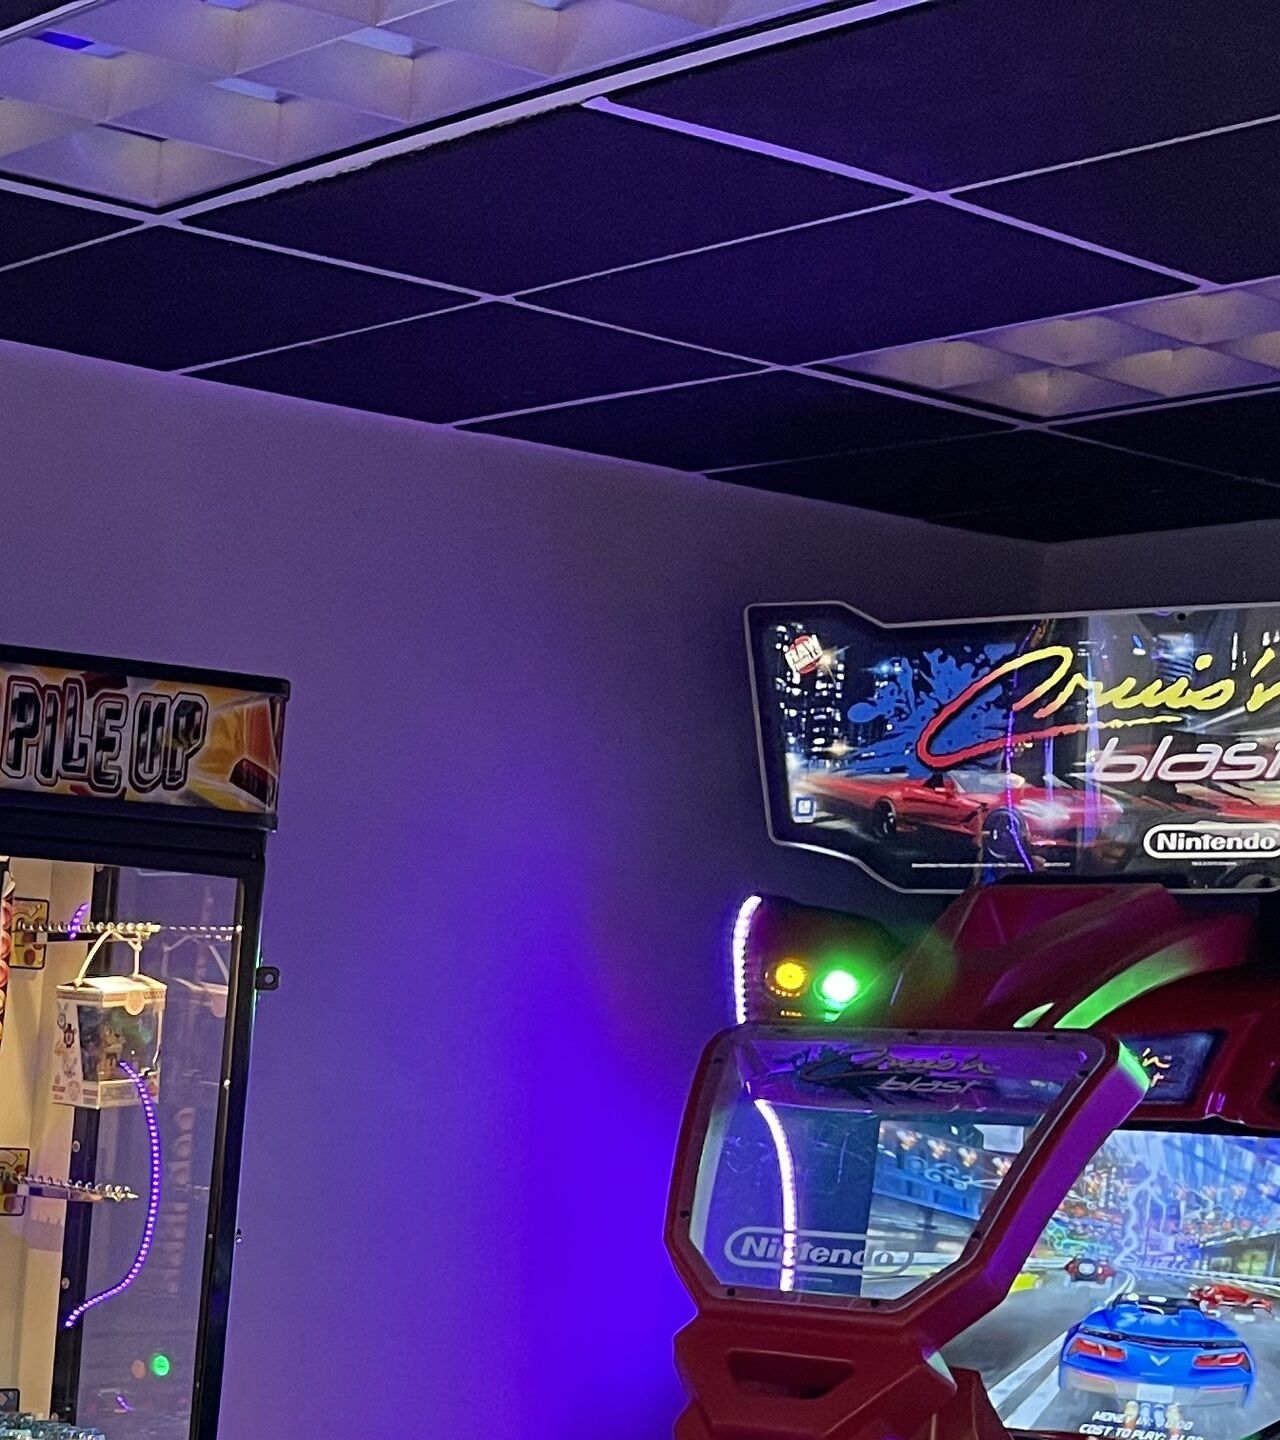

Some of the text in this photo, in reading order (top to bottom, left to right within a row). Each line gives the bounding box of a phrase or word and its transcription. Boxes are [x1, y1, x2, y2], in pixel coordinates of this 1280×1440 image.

[0, 674, 210, 794] PILE UP
[1093, 734, 1280, 783] blas
[1156, 831, 1277, 852] Nintendo
[876, 1075, 982, 1093] blast
[1078, 1423, 1114, 1437] COST
[1114, 1427, 1132, 1438] TO
